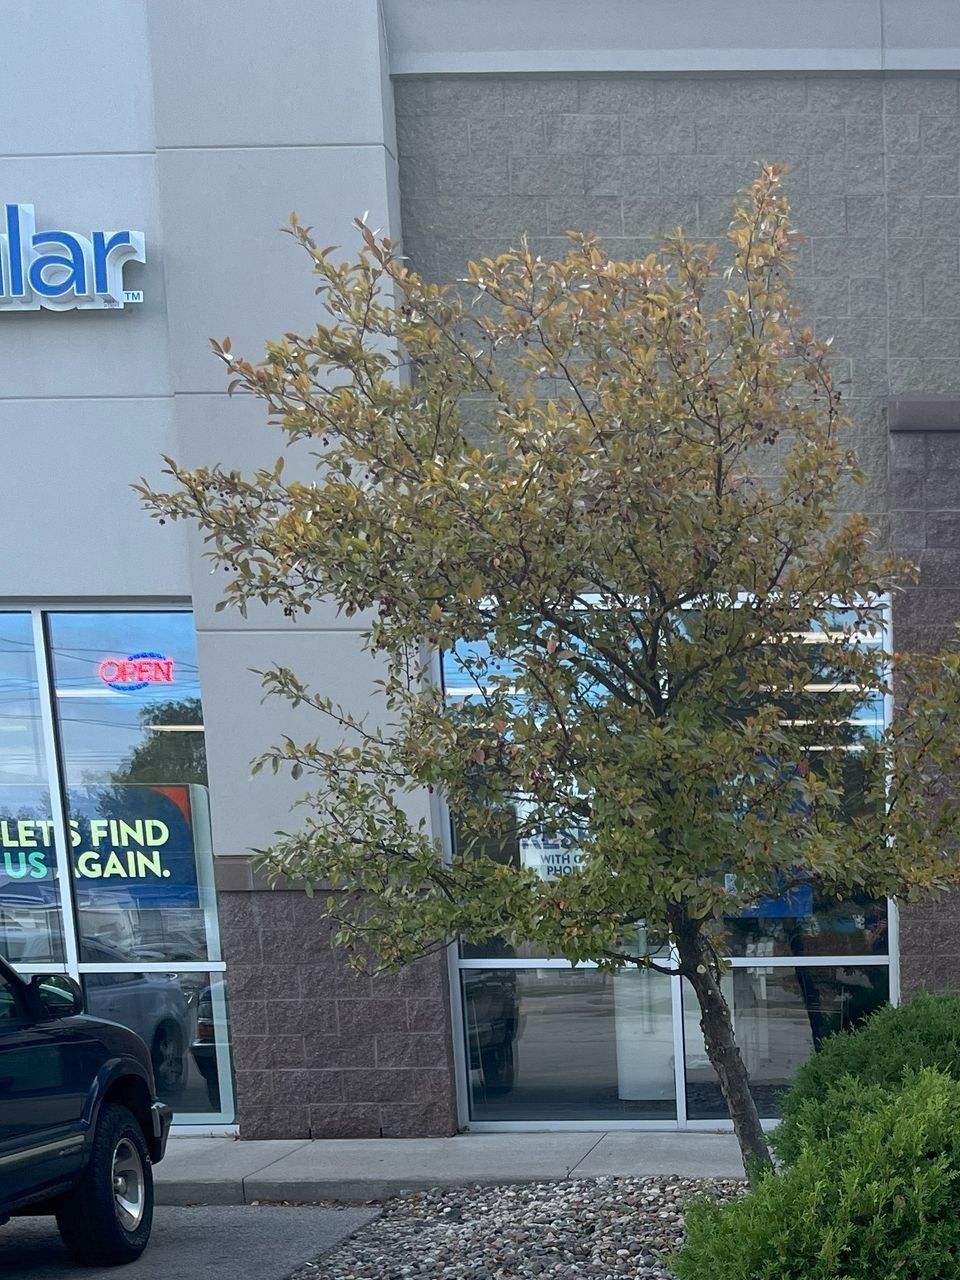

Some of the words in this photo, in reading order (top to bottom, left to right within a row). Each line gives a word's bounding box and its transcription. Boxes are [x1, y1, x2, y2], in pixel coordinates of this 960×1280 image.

[0, 203, 132, 298] lar
[124, 292, 141, 301] TM
[99, 660, 173, 682] OPEN
[1, 820, 82, 847] LETS
[90, 819, 170, 847] FIND
[4, 851, 48, 879] US
[56, 851, 171, 878] GAIN.
[541, 854, 571, 865] WITH
